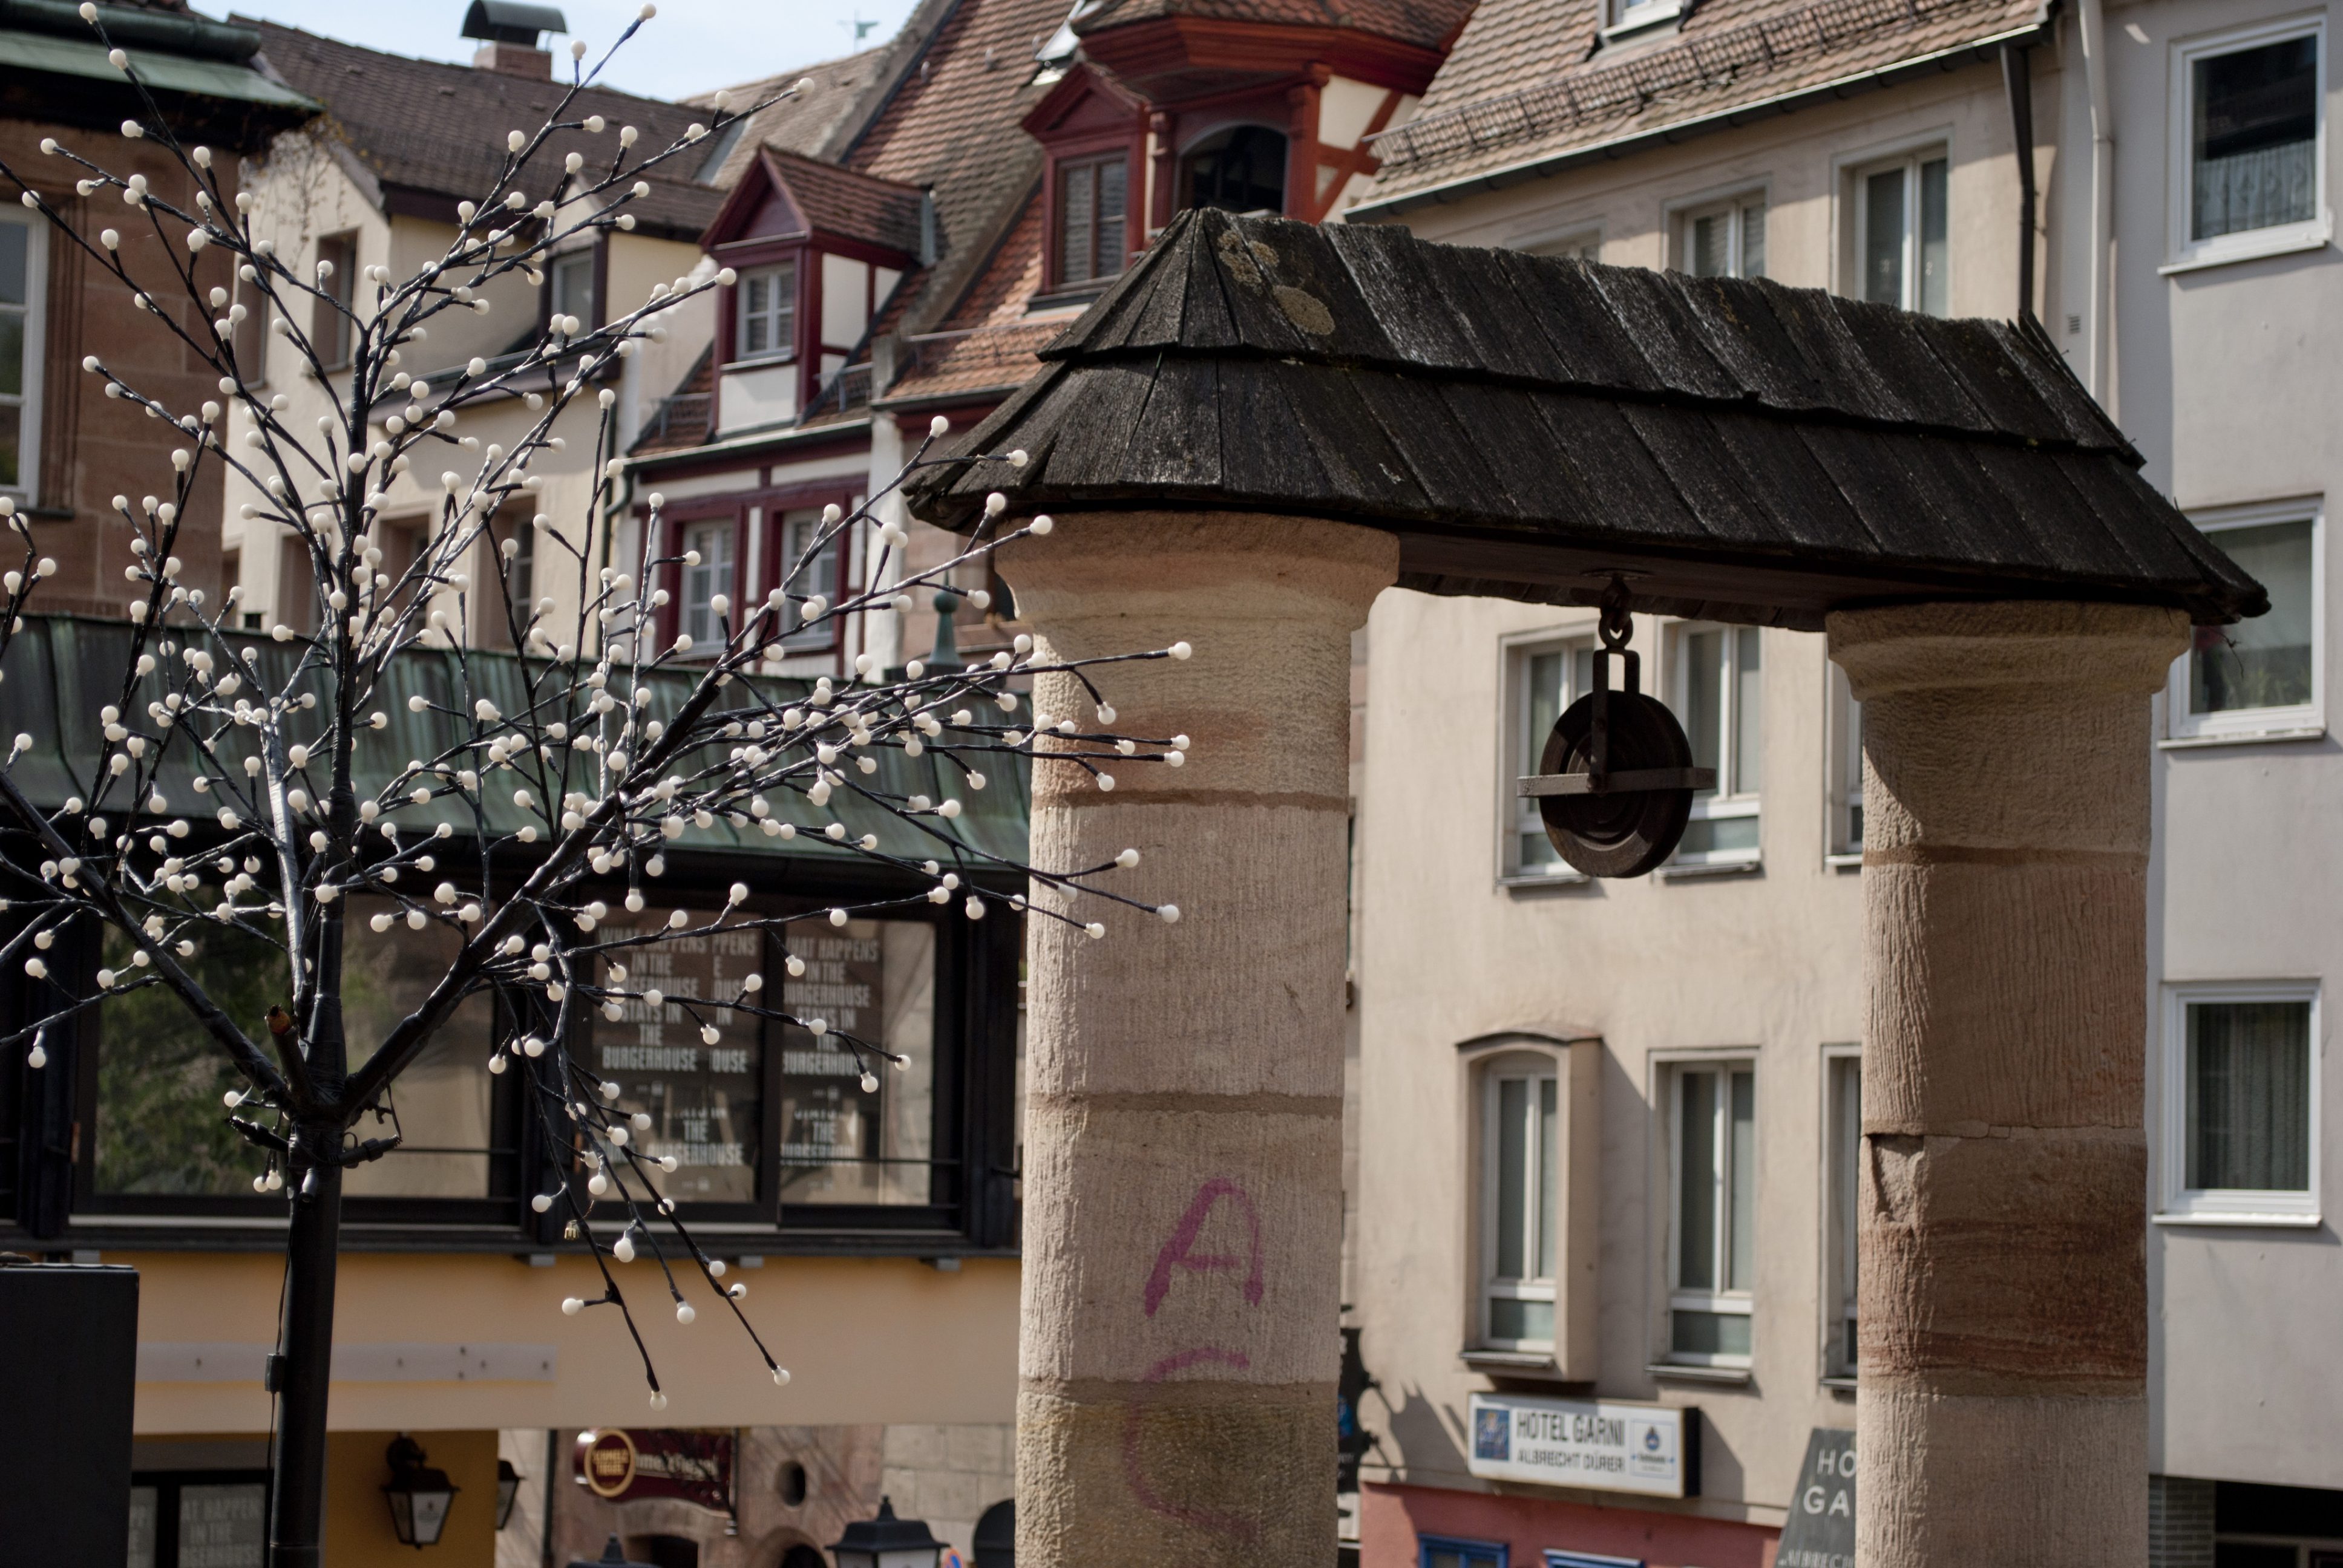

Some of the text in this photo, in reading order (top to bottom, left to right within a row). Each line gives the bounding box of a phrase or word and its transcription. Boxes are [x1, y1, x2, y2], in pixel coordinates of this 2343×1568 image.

[603, 1045, 698, 1071] BURGERHOUSE
[1516, 1411, 1626, 1447] HOTEL GARNI
[1517, 1448, 1581, 1469] ALBRECHT
[1583, 1450, 1626, 1473] DÜRER
